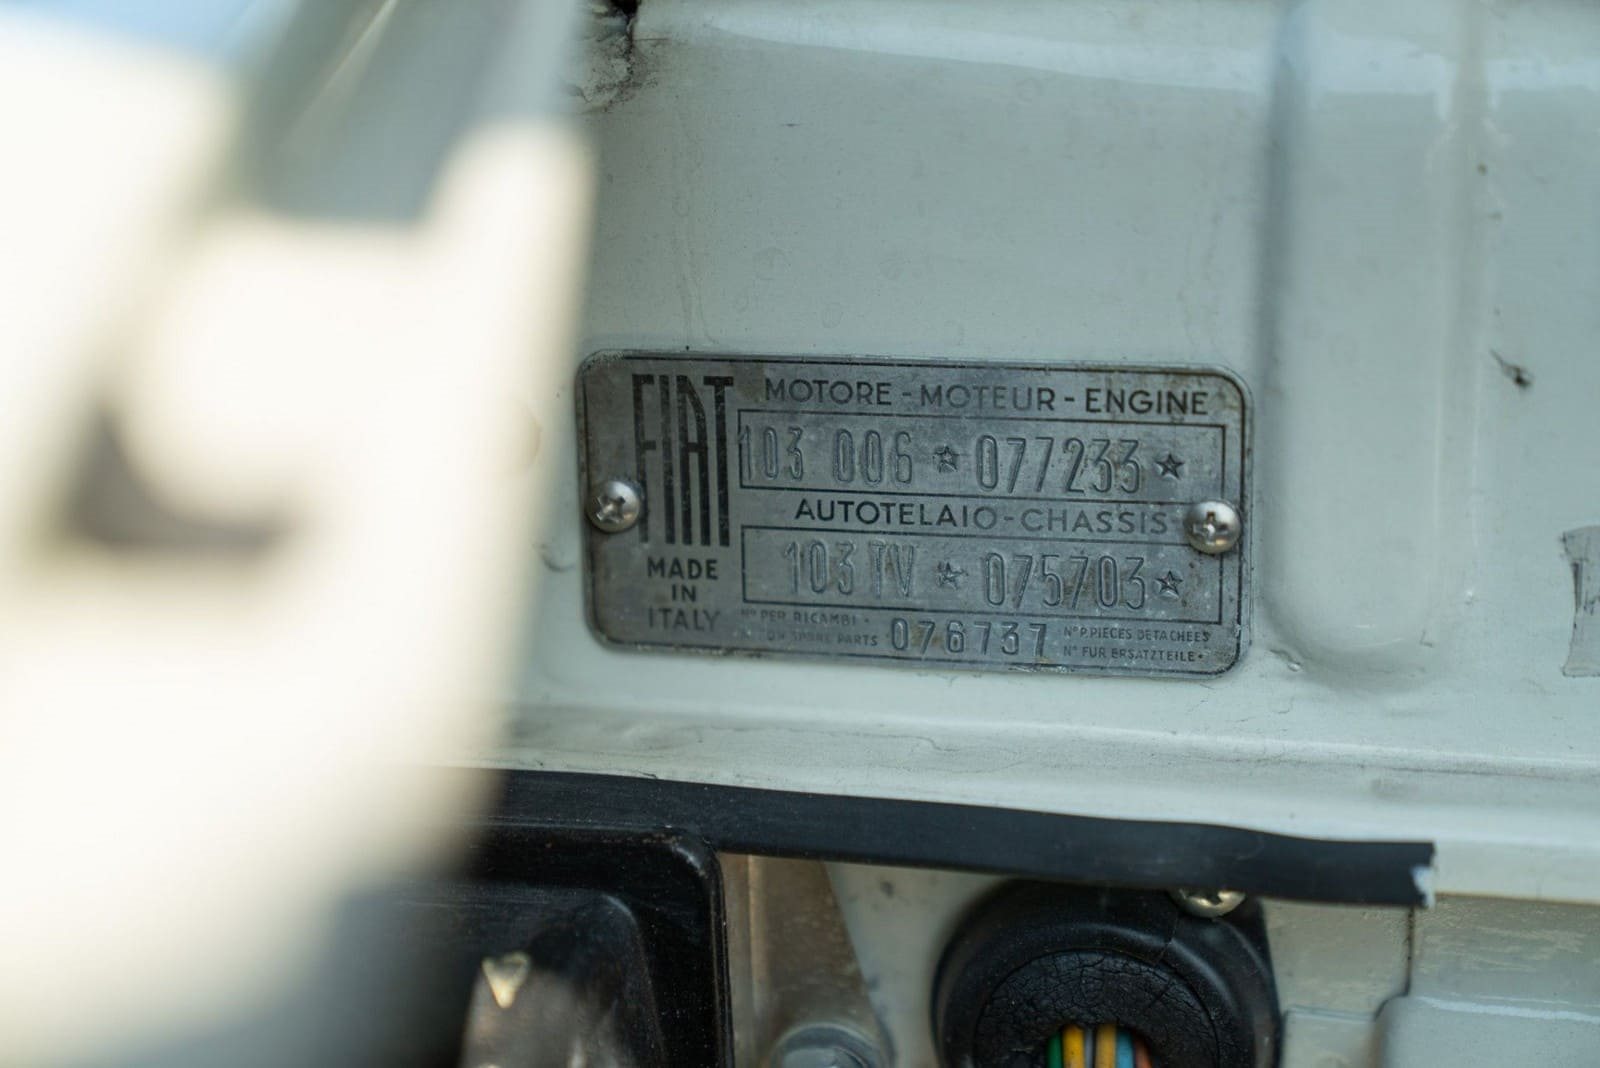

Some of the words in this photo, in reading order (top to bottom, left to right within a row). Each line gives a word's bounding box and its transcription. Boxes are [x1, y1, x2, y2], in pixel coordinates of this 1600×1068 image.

[765, 378, 892, 405] MOTORE
[921, 384, 1055, 411] MOTEUR
[1086, 388, 1208, 415] ENGINE
[632, 374, 734, 547] FIAT
[738, 425, 804, 481] 103
[833, 428, 913, 486] 006
[975, 434, 1142, 495] 077233
[647, 557, 719, 580] MADE
[985, 552, 1147, 610] 075703
[671, 584, 697, 602] IN
[649, 607, 721, 632] ITALY
[891, 617, 1048, 658] 076737
[837, 634, 878, 647] PARTS
